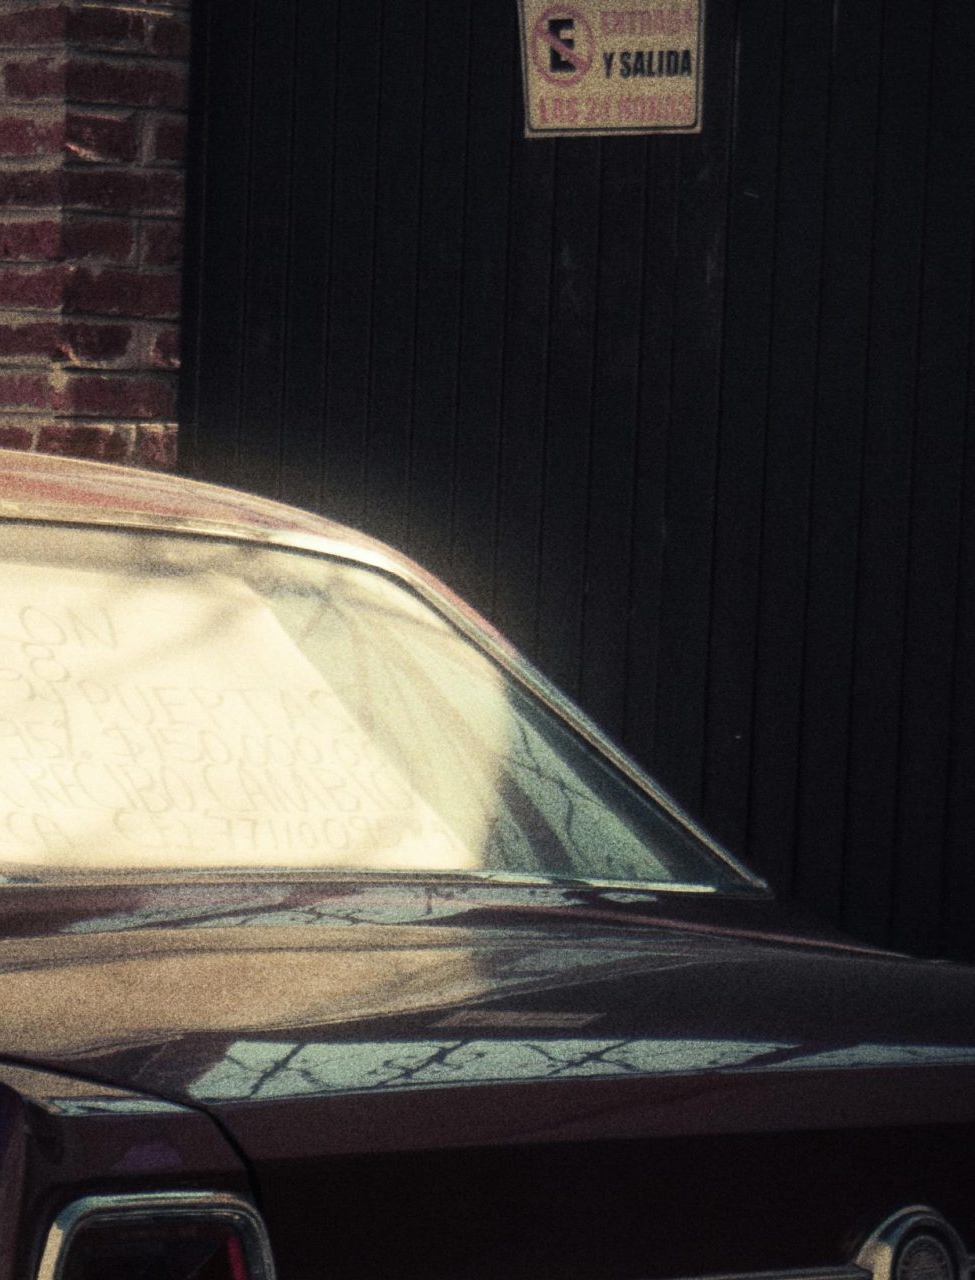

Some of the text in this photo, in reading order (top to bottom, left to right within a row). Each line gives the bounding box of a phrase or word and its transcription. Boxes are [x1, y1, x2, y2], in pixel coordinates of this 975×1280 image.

[603, 49, 693, 78] Y SALIDA
[539, 97, 578, 123] LAS
[617, 93, 693, 121] HORAS
